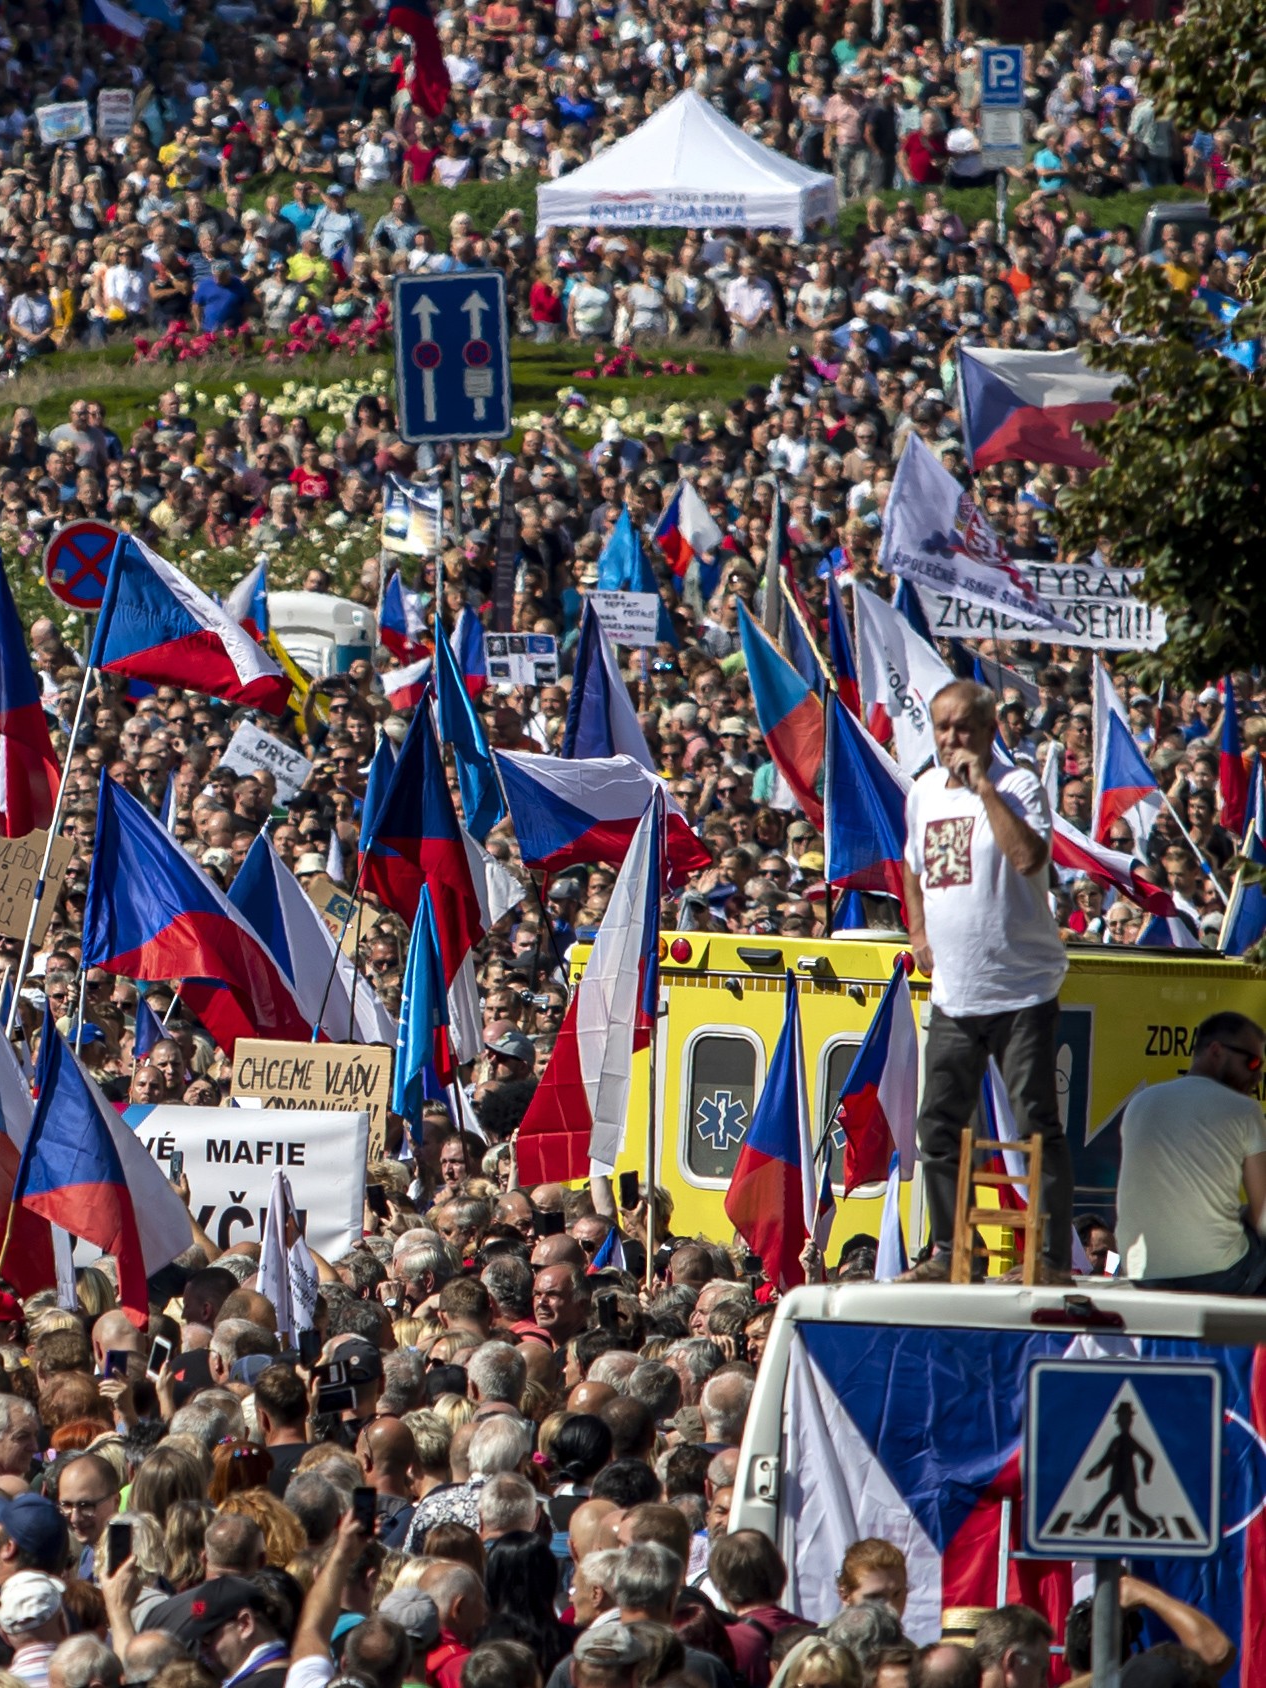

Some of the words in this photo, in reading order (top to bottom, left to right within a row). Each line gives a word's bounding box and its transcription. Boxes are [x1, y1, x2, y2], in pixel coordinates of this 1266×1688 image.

[15, 877, 33, 900] A
[238, 1057, 315, 1090] CHCEME
[325, 1055, 381, 1098] VLÁDU
[205, 1138, 306, 1166] MAFIE
